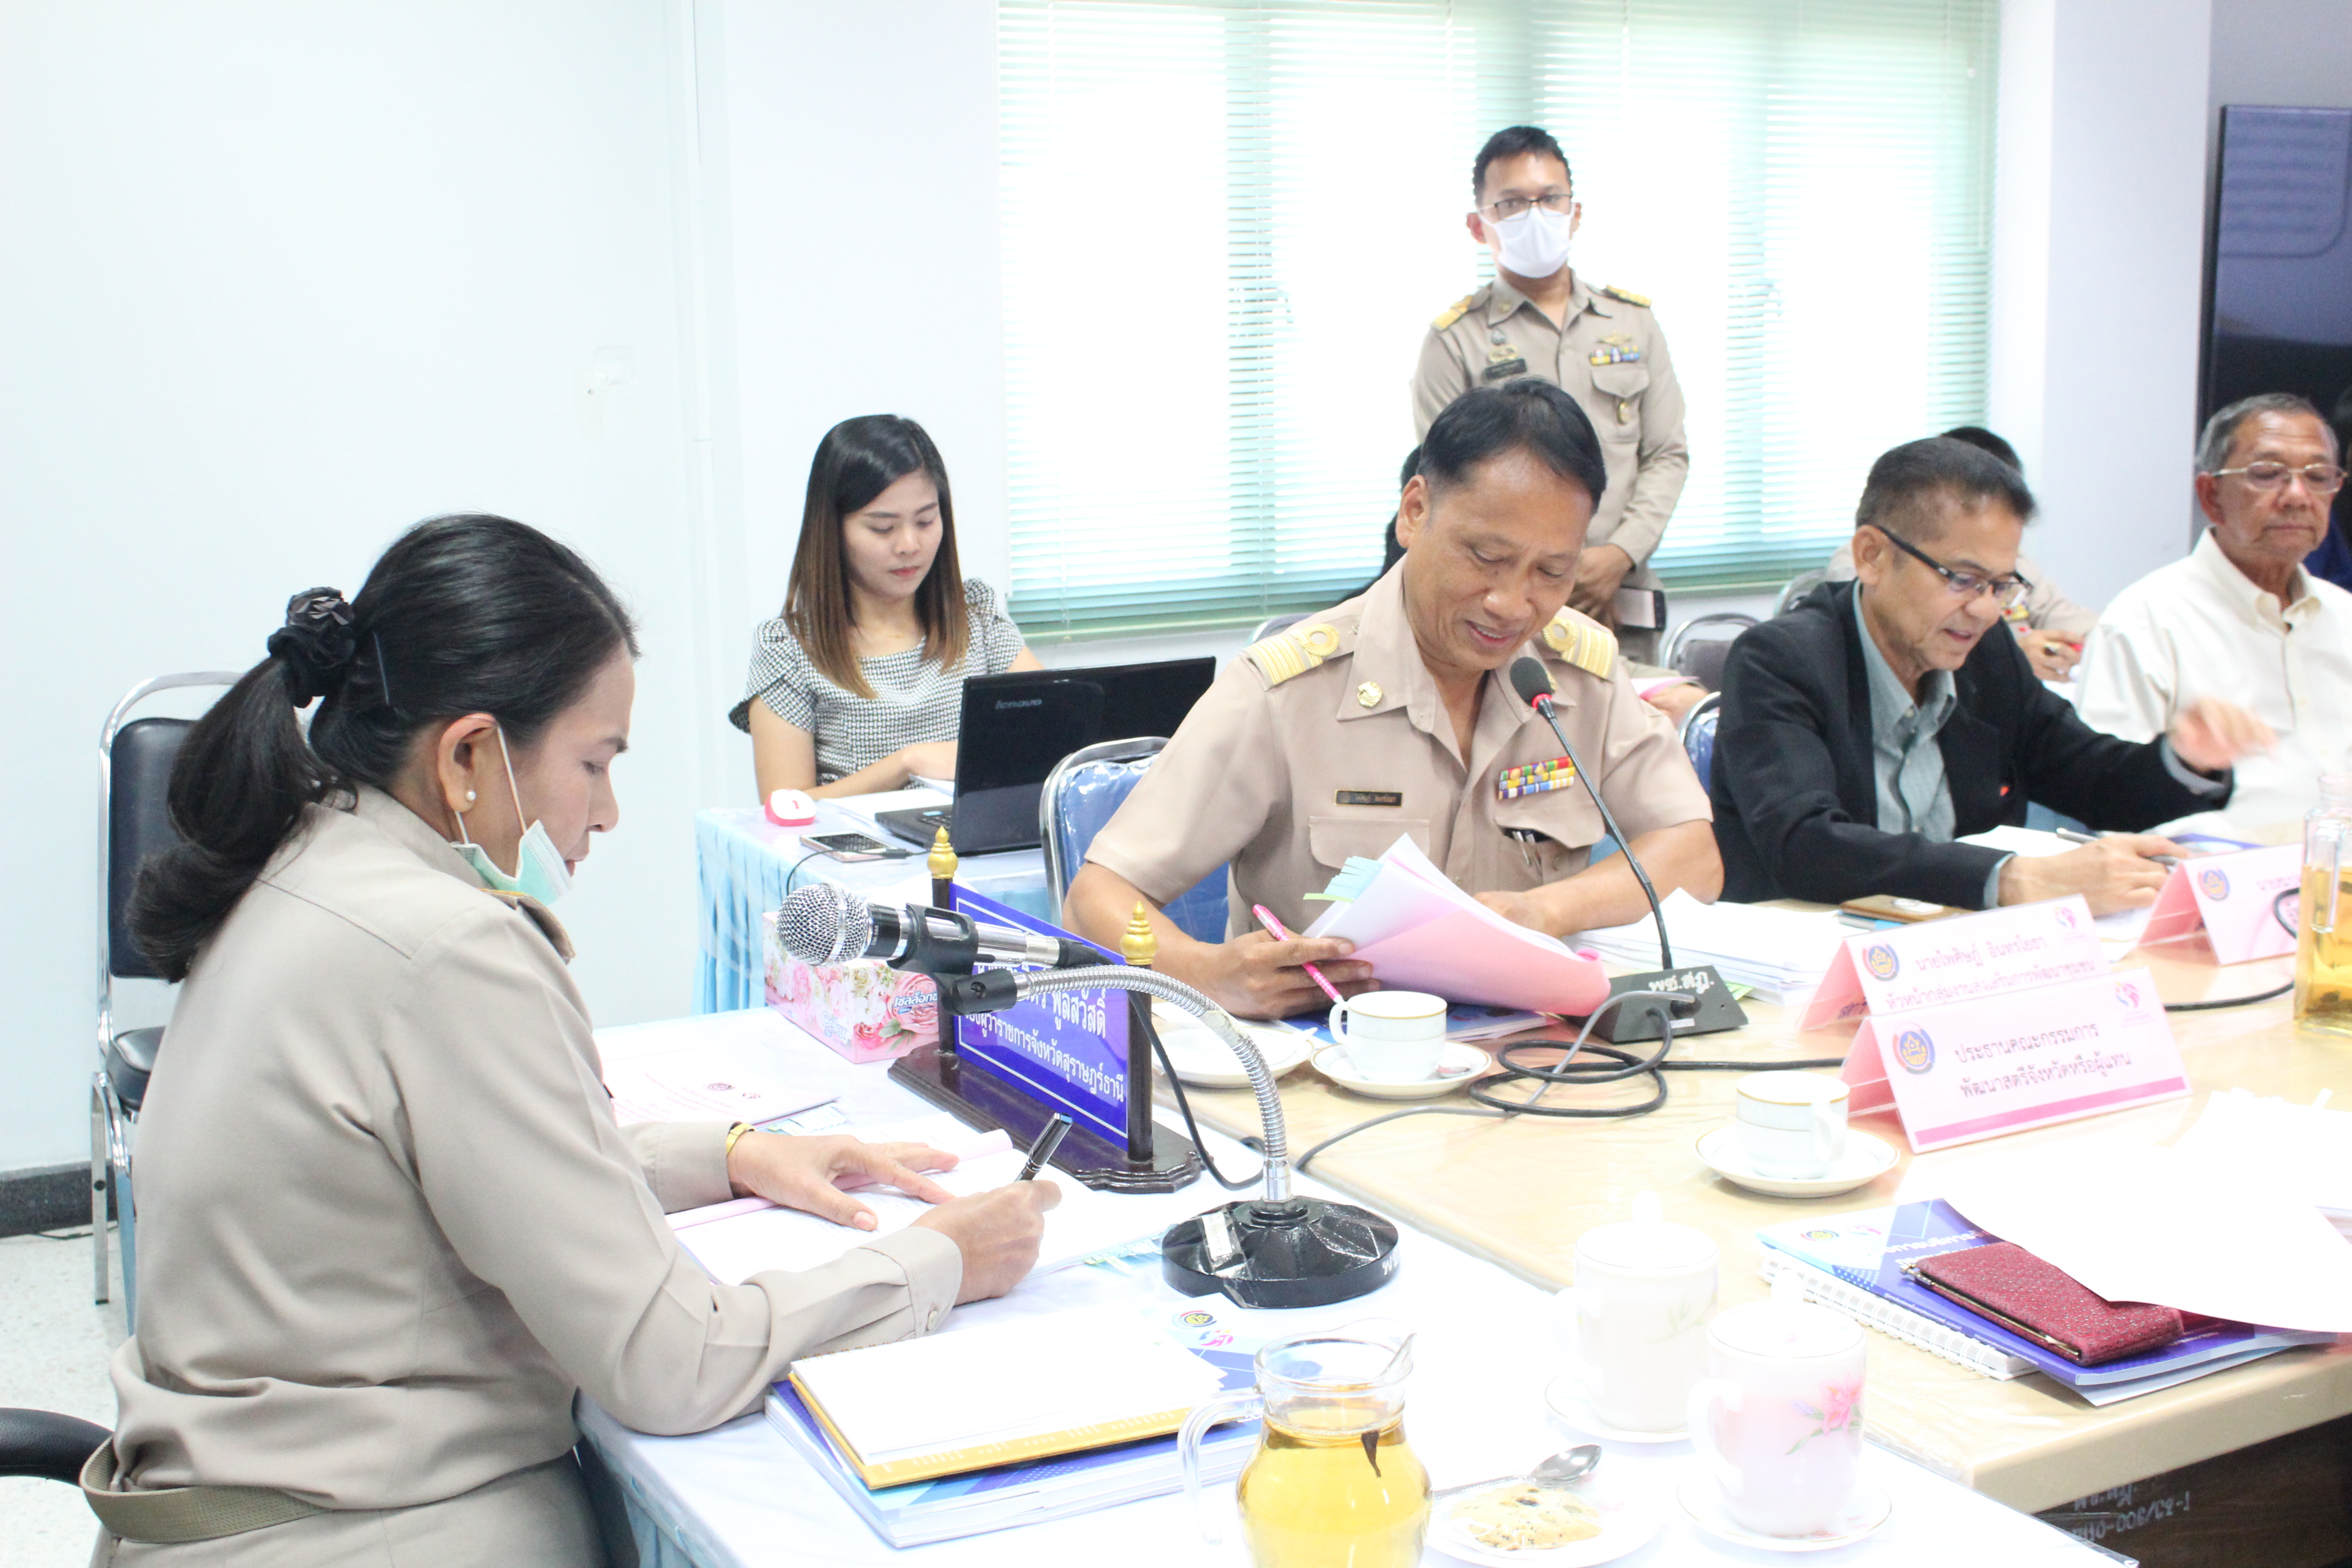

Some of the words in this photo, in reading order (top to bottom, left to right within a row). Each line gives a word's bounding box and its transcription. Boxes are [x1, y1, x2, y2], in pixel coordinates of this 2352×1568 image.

[995, 699, 1042, 709] lenovo
[894, 990, 938, 1007] เซลล็อกซ
[822, 1010, 847, 1040] Cellox
[1955, 1023, 2100, 1063] ประธานคณะกรรมการ
[1960, 1051, 2132, 1098] พัฒนาสตรีจังหวัดหรือผู้แทน
